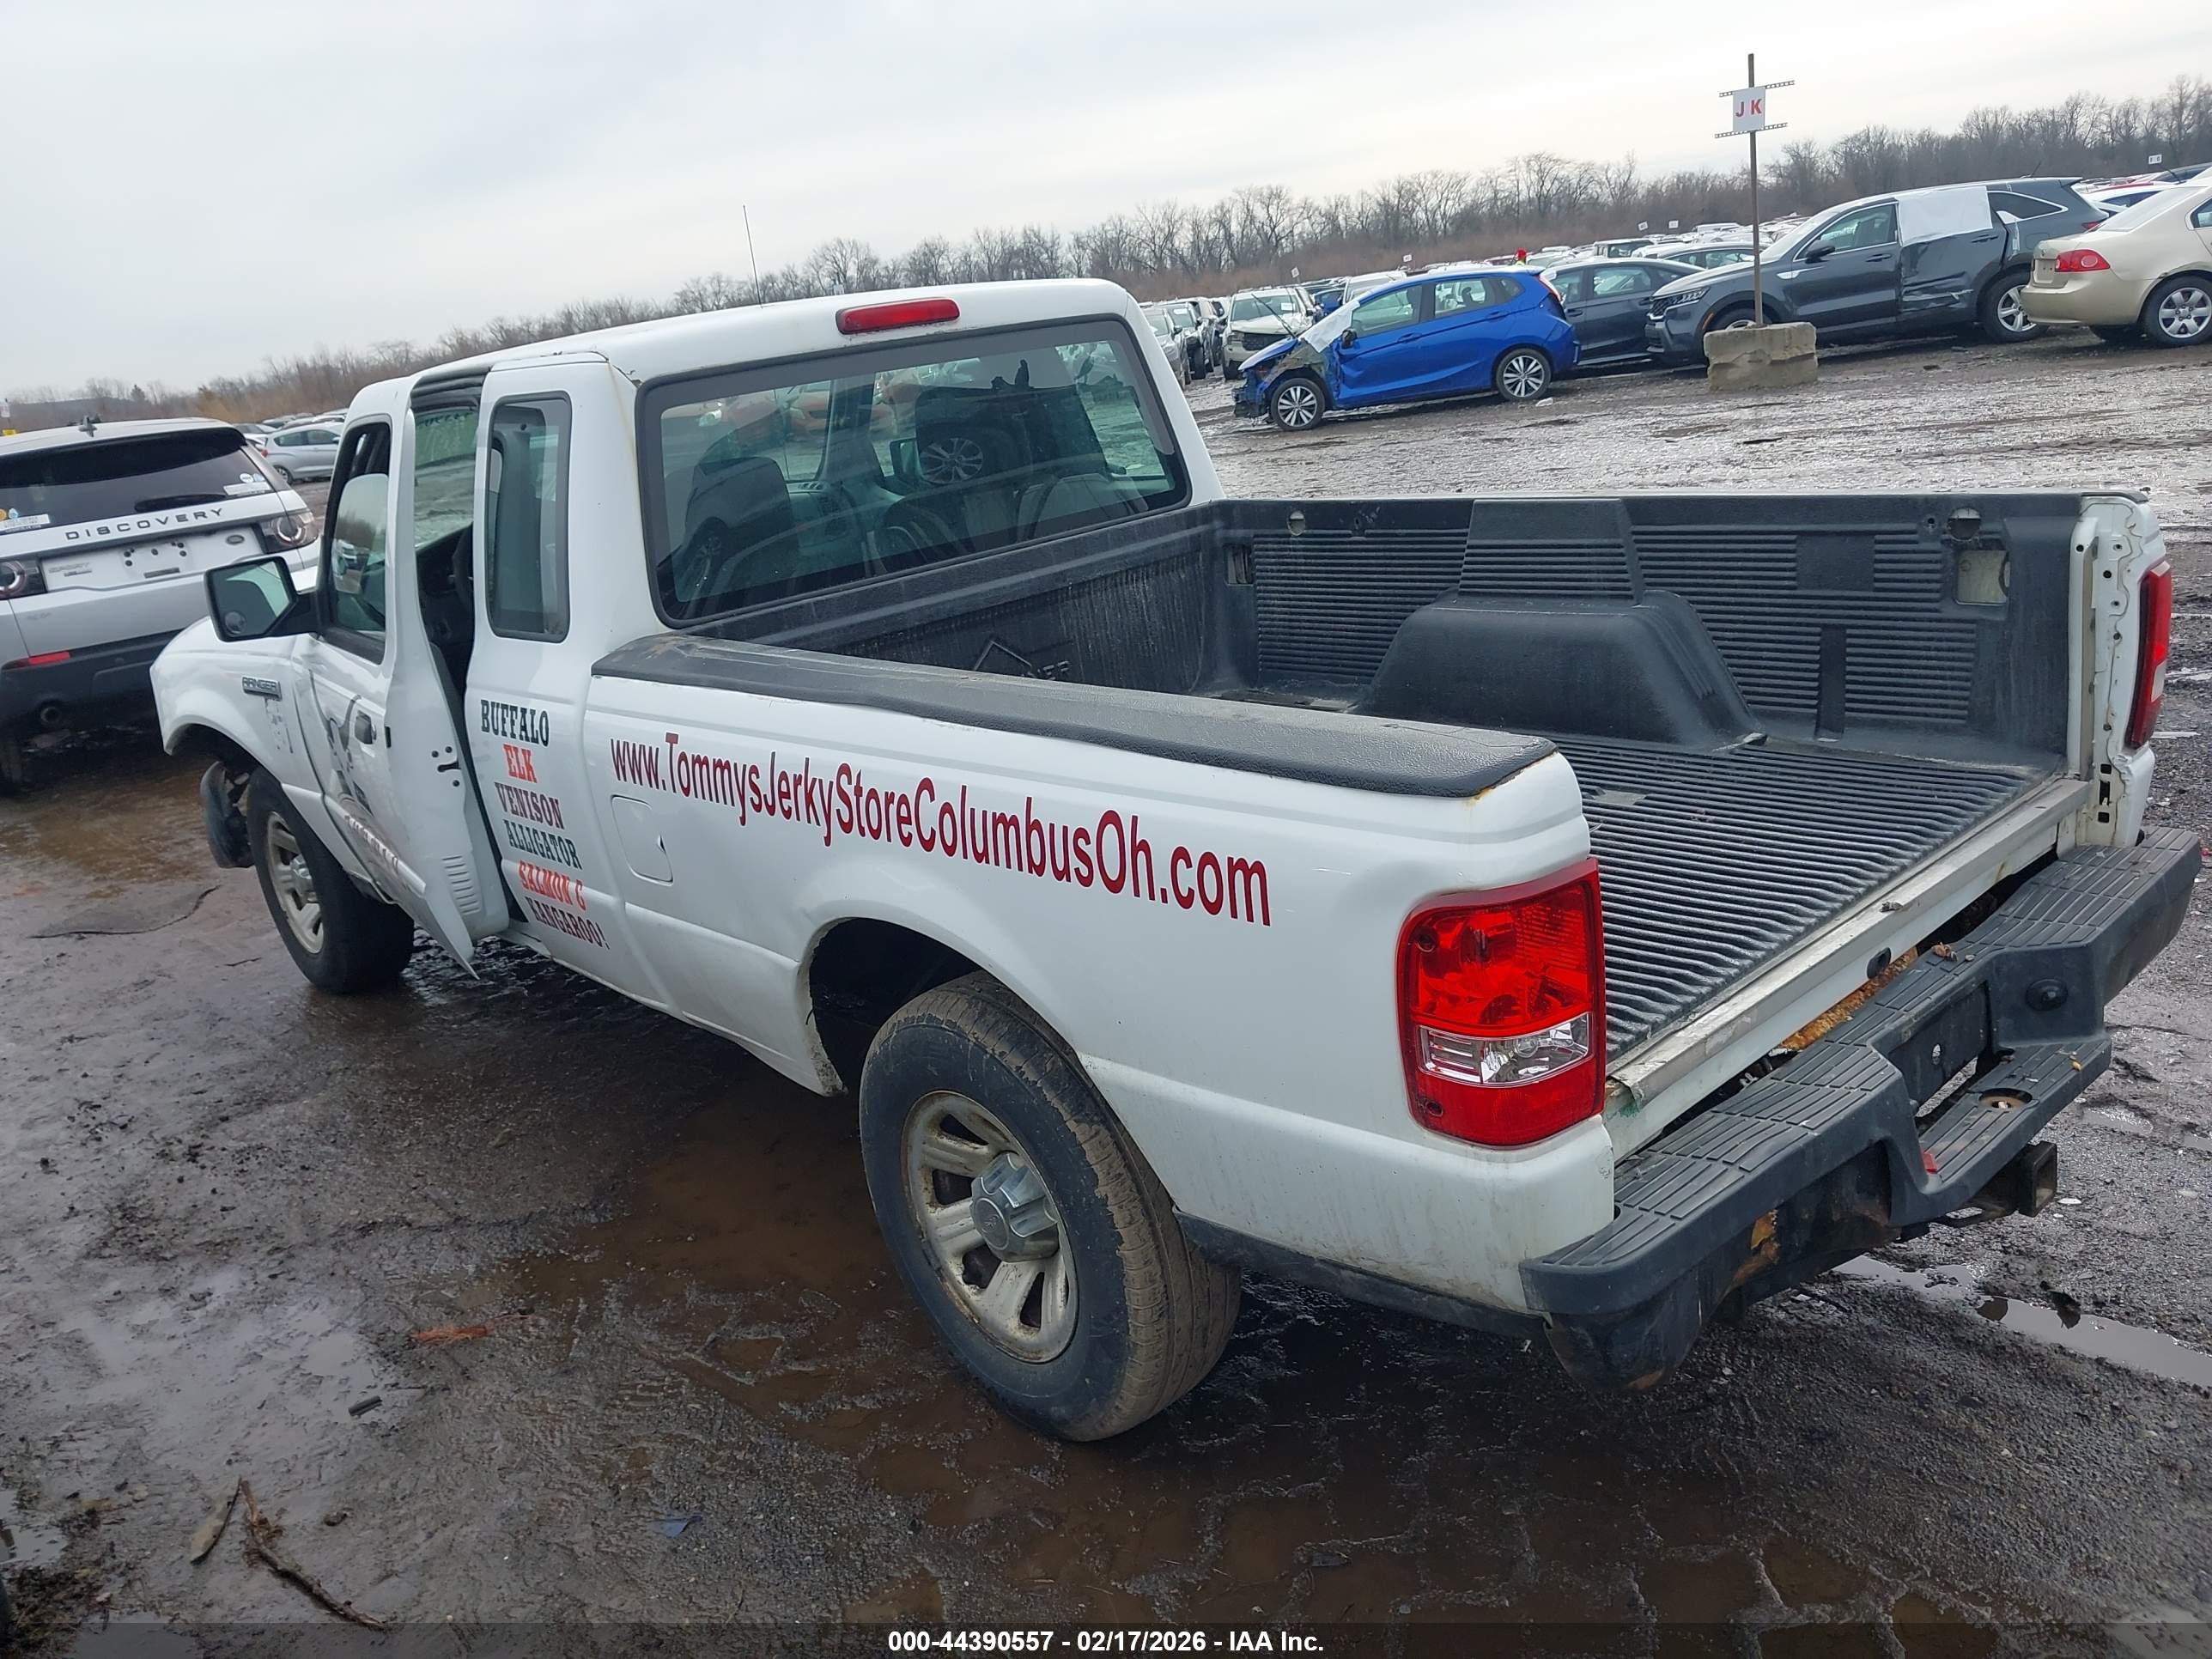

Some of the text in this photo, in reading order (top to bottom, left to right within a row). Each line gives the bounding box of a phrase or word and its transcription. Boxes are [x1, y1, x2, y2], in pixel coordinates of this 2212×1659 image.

[65, 507, 222, 541] DISCOVERY
[481, 699, 550, 747] BUFFALO
[503, 744, 538, 783] ELK
[495, 782, 564, 830] VENISON
[611, 732, 1272, 927] www.TommysJerkyStoreColumbusOh.com
[503, 819, 583, 870] ALLIGATOR
[519, 860, 574, 905] SALMON
[525, 896, 611, 951] KANGAROO!
